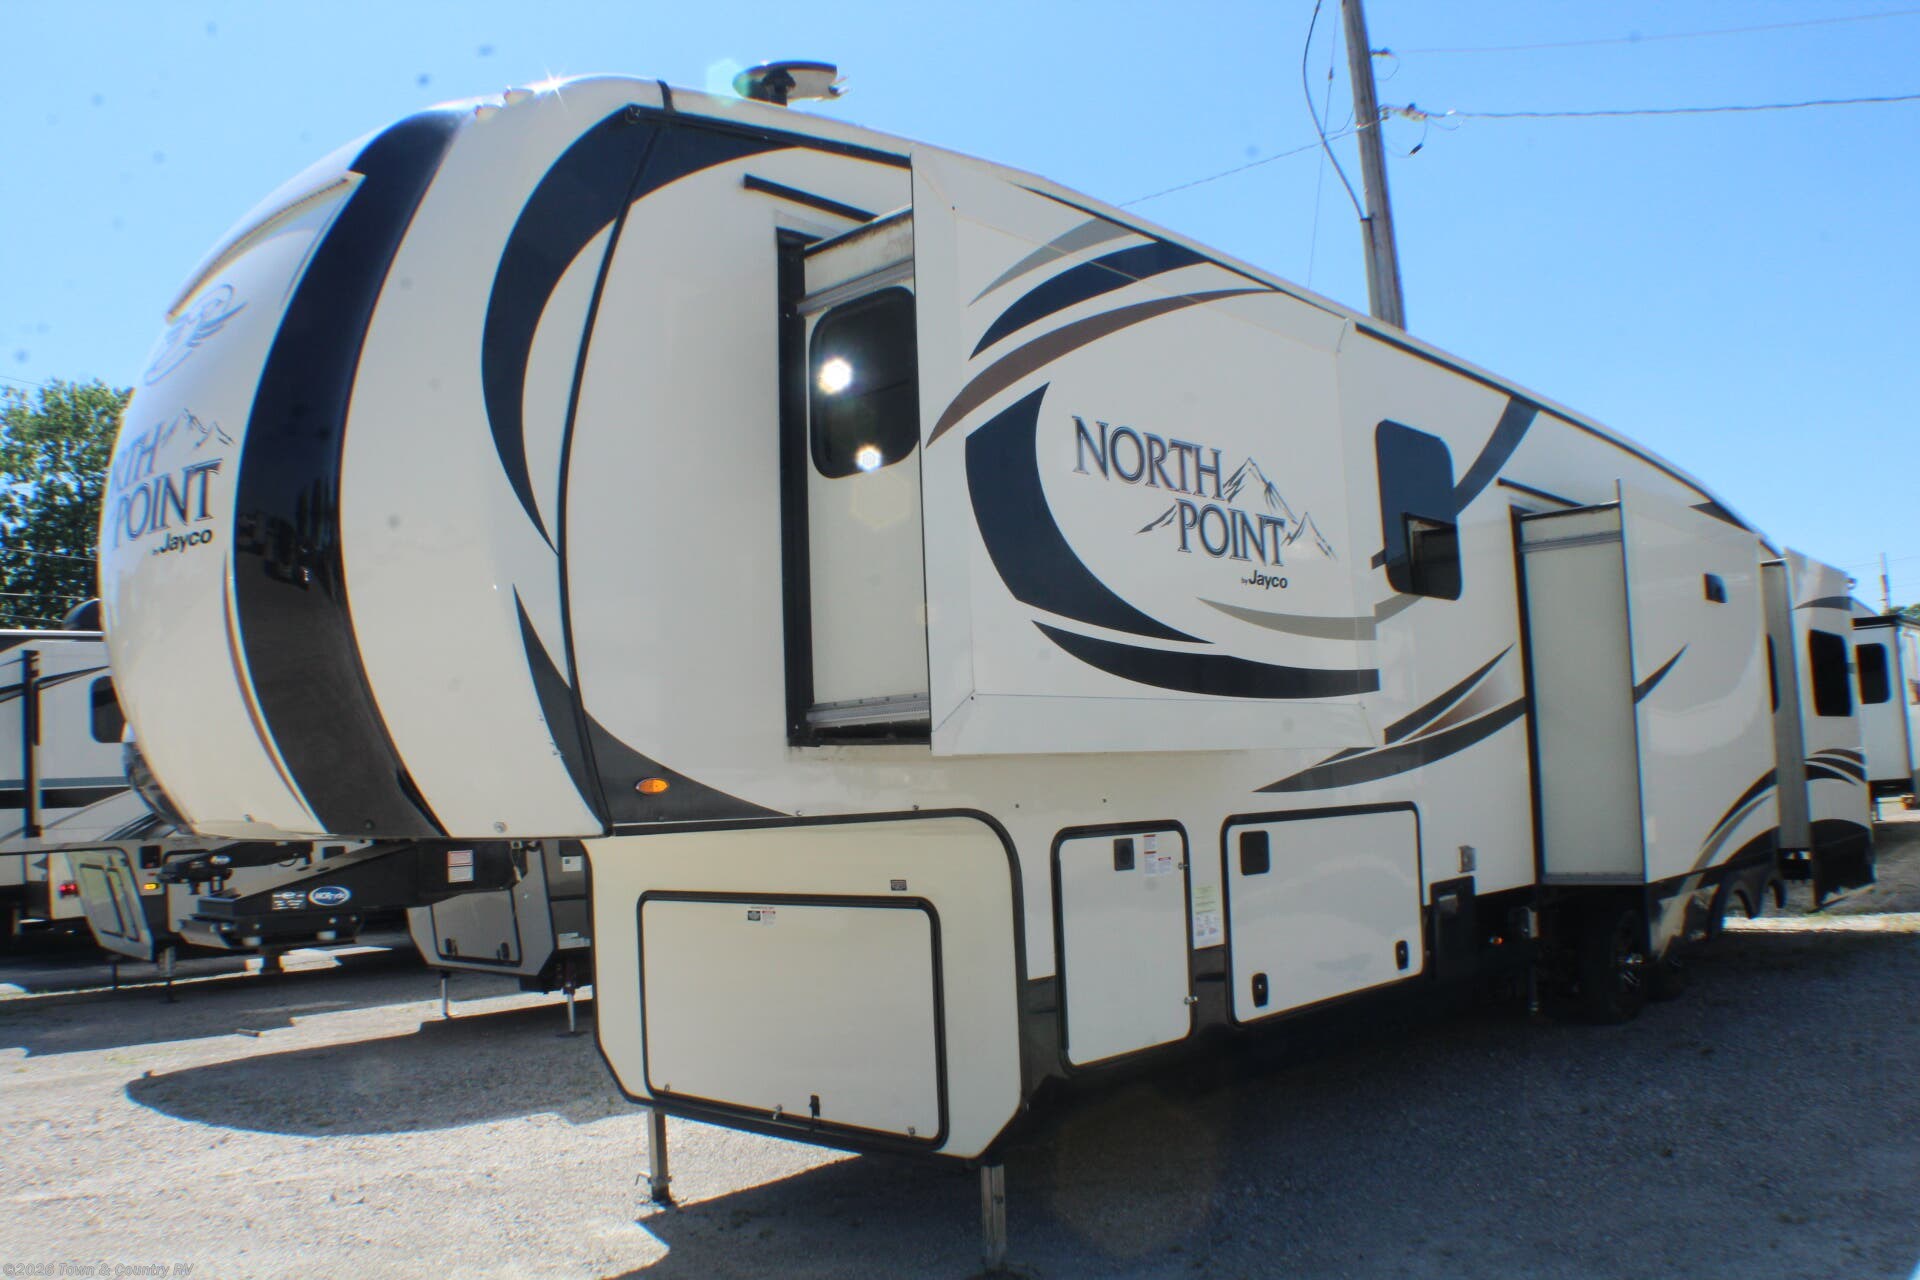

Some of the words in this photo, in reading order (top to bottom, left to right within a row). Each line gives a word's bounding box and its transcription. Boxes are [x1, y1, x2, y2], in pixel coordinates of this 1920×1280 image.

[1071, 415, 1225, 501] NORTH
[112, 457, 223, 551] POINT
[1175, 498, 1285, 567] POINT
[160, 529, 213, 554] Jayco
[1248, 569, 1288, 590] Jayco
